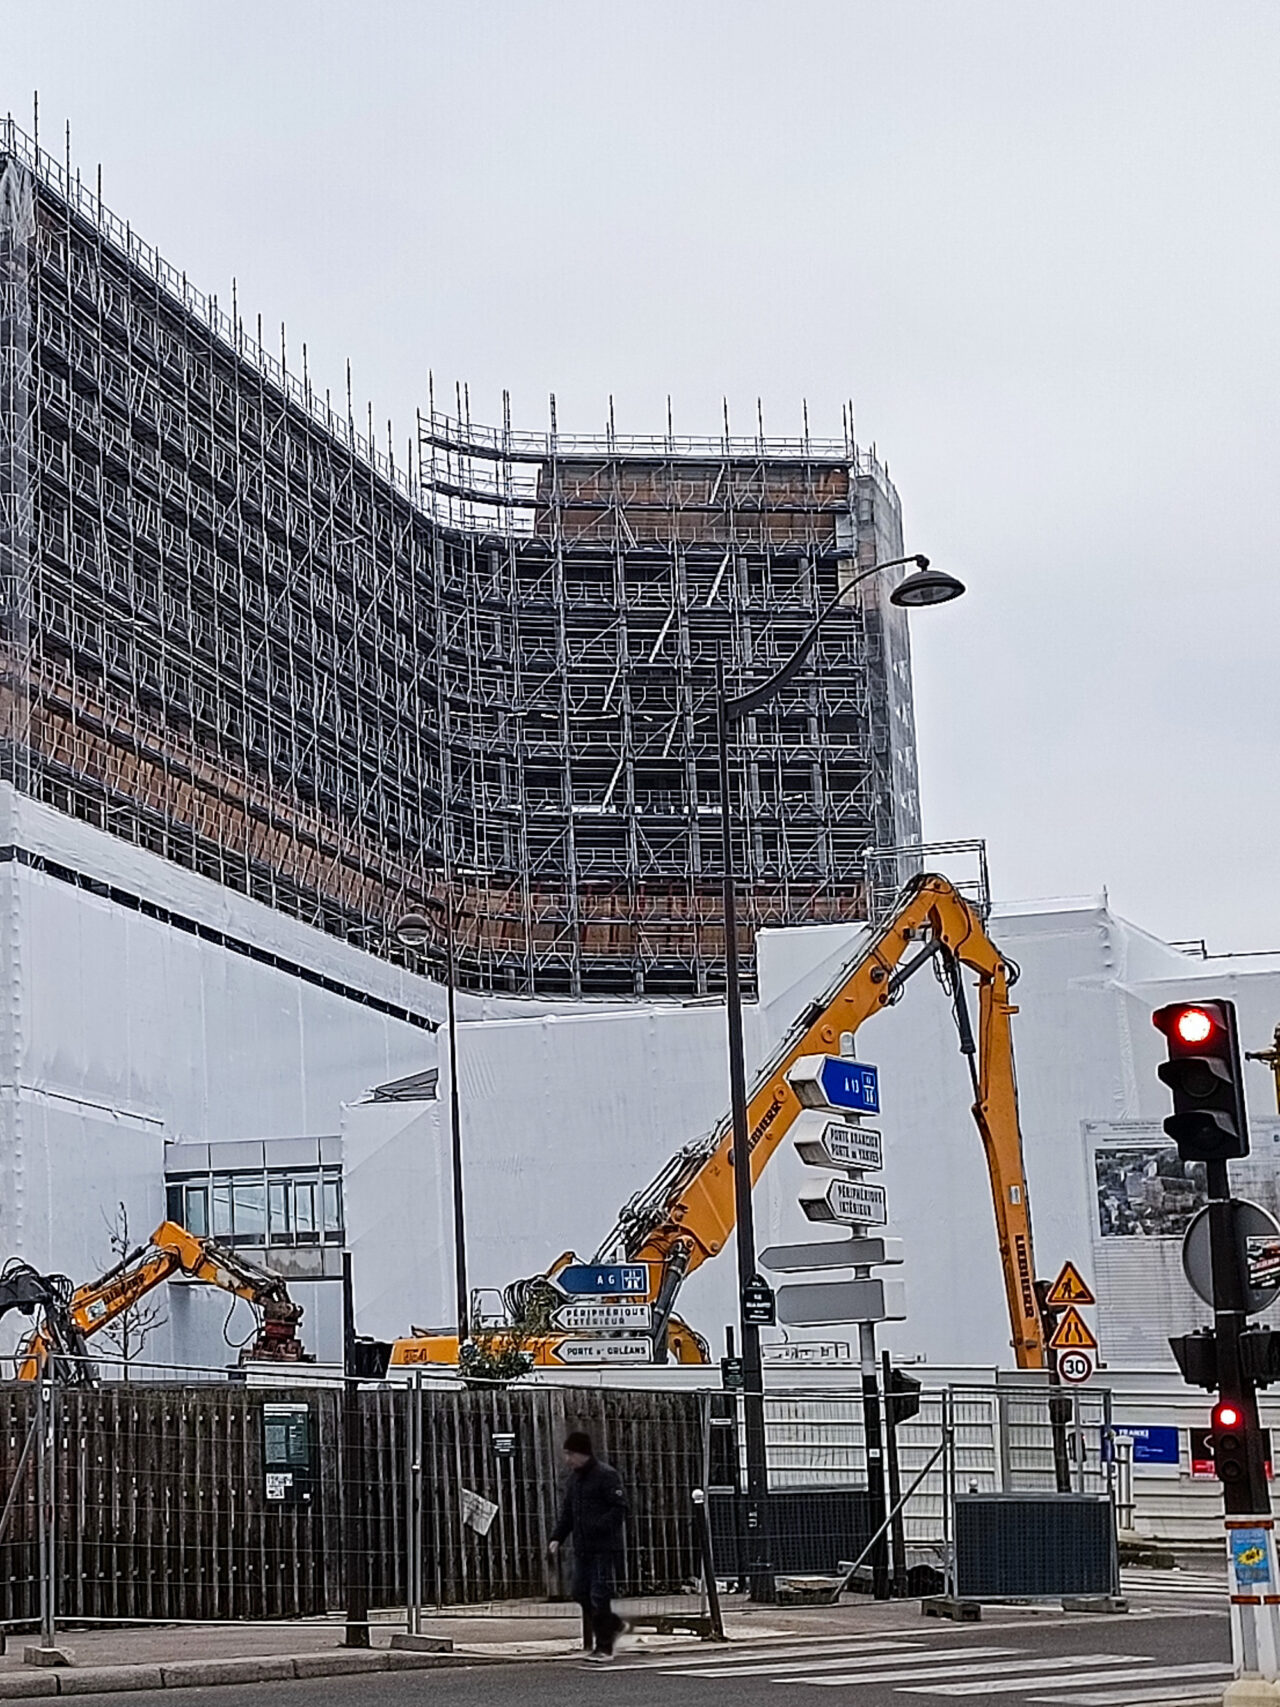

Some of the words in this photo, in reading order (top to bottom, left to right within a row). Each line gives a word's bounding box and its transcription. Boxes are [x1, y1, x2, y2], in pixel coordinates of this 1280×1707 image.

[596, 1275, 604, 1285] A
[1015, 1234, 1035, 1319] LIEBHERR
[566, 1308, 645, 1317] PÉRIPHÉRIQUE
[567, 1317, 625, 1326] EXTÉRIEUR
[567, 1347, 593, 1356] PORTE
[1065, 1359, 1086, 1375] 30
